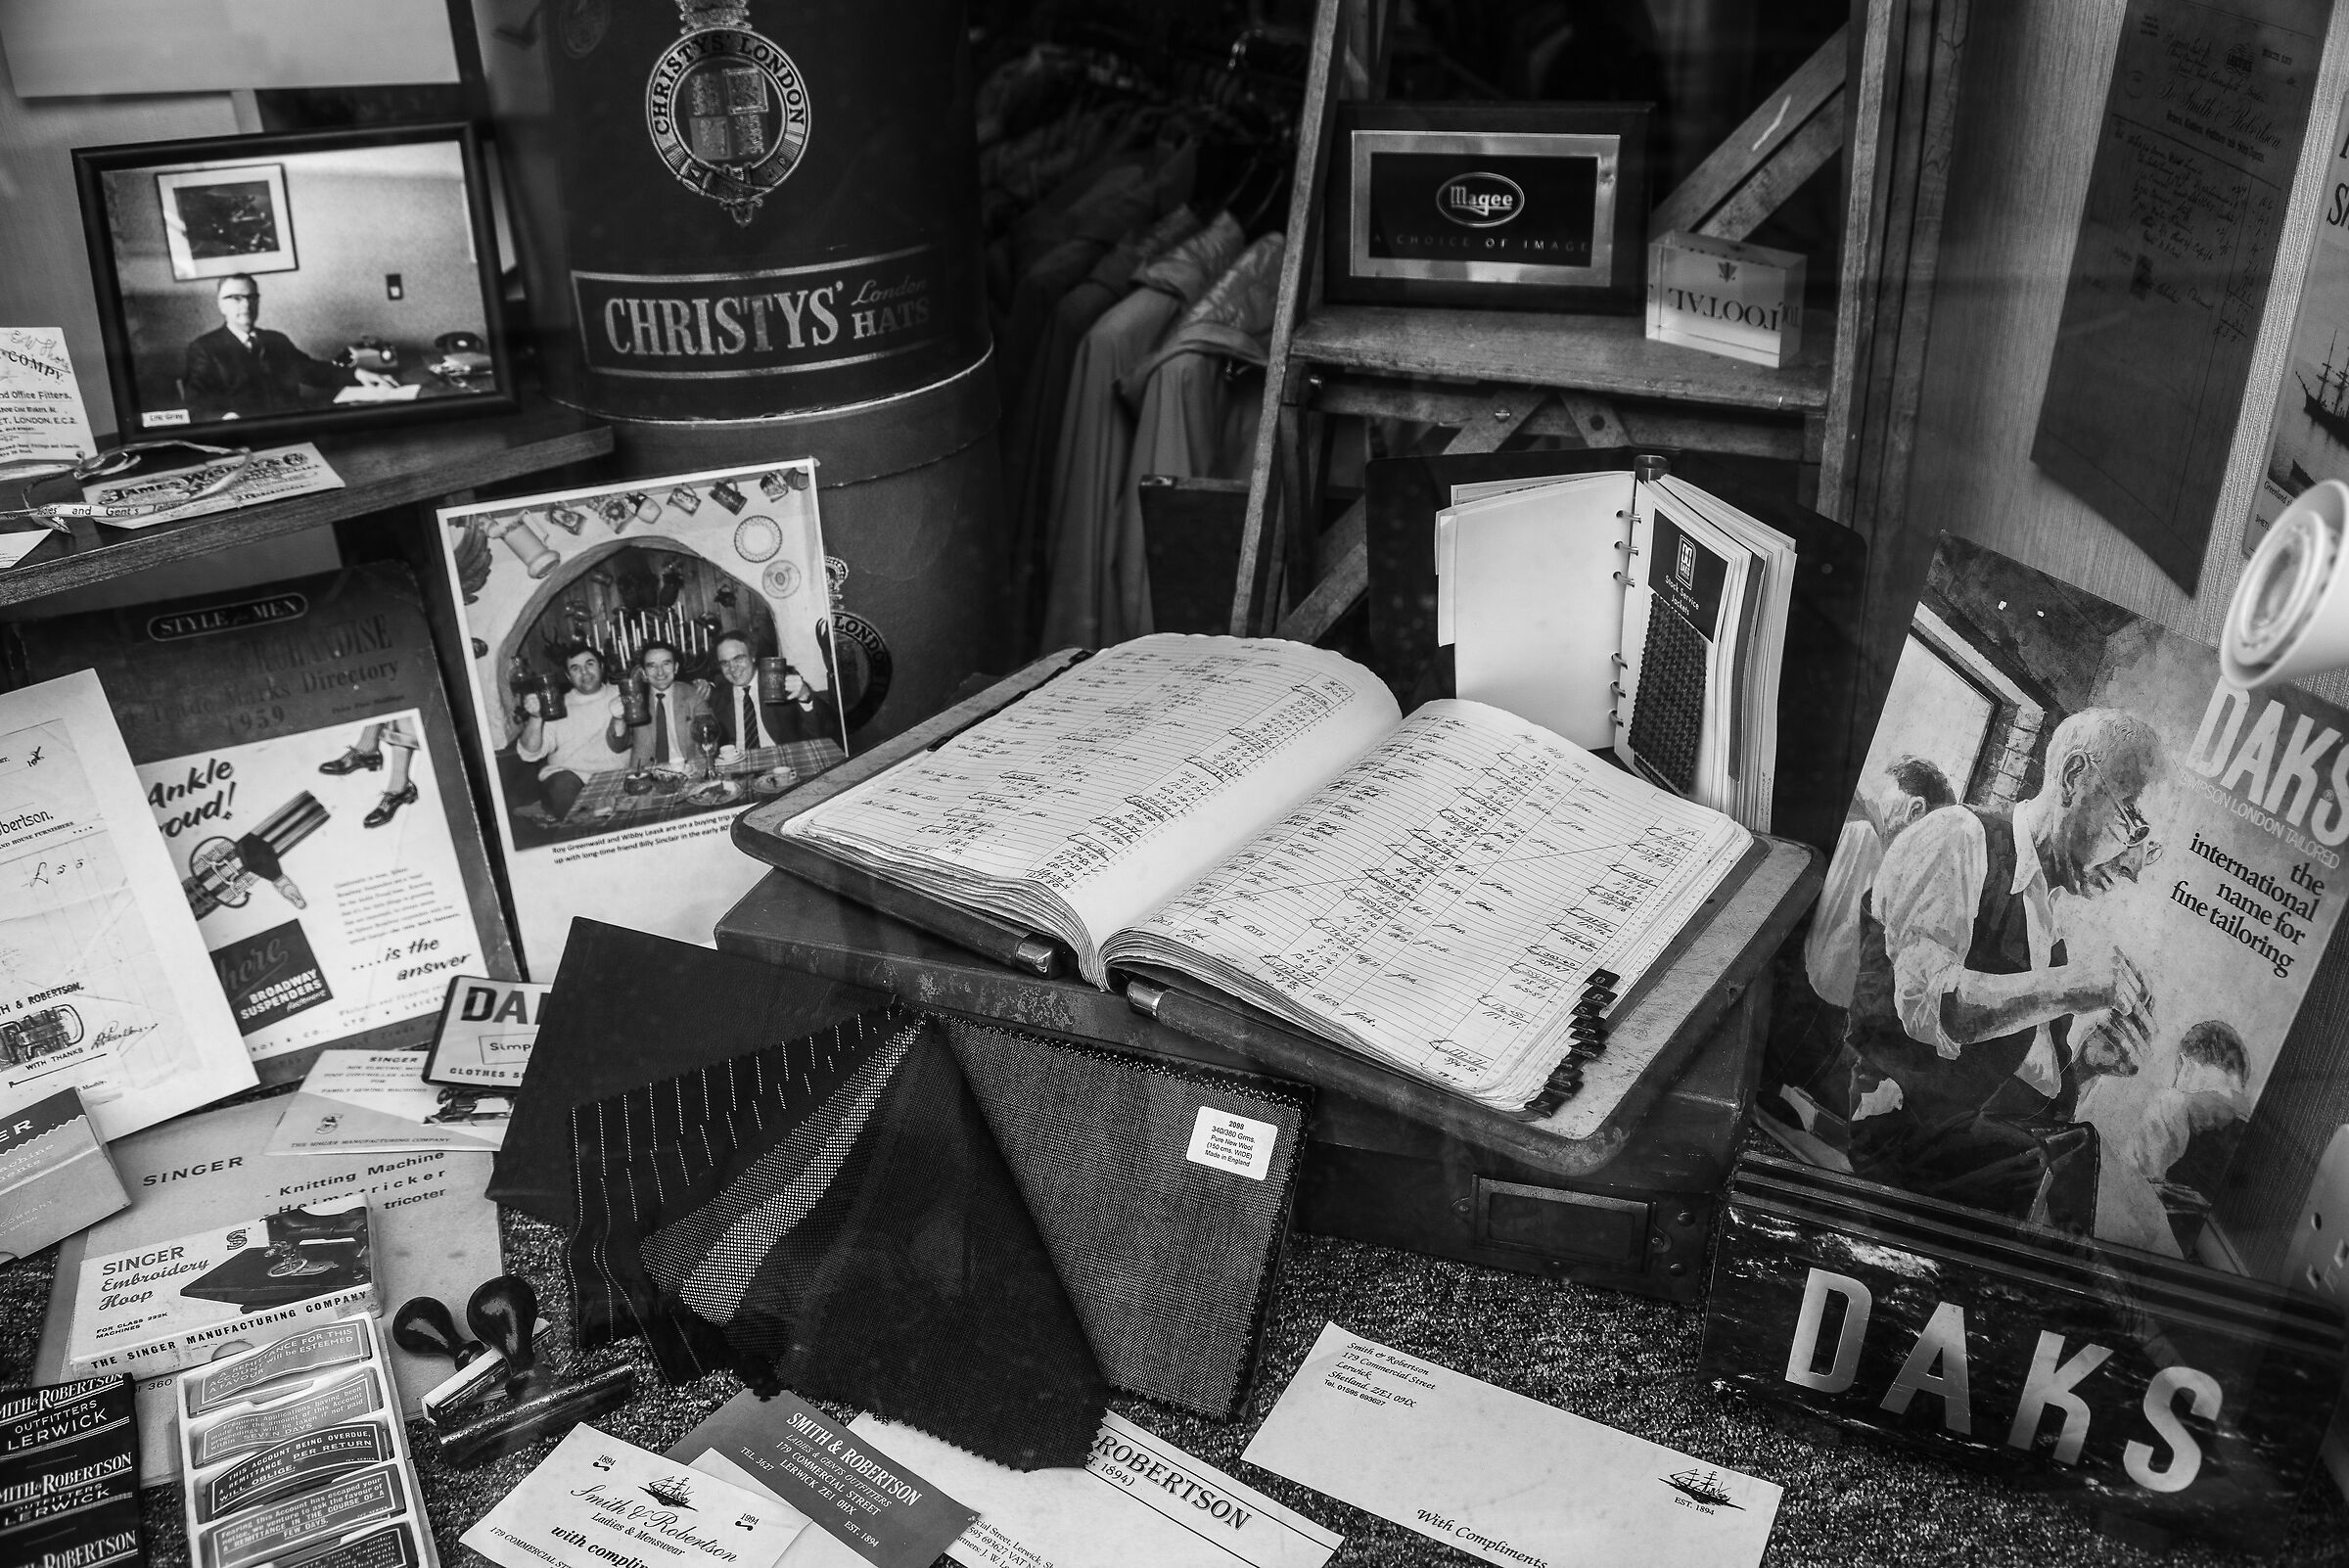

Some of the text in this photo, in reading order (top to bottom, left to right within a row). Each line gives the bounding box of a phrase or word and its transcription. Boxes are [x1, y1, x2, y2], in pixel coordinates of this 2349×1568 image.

[652, 33, 806, 135] CHRISTYS' LONDON
[1451, 185, 1513, 215] Magee
[1396, 235, 1589, 252] CHOICE OF IMAGE
[604, 279, 930, 355] CHRISTYS' London HATS
[1668, 287, 1782, 331] TOOTAL
[12, 391, 36, 399] Office
[72, 505, 92, 516] and
[1665, 574, 1700, 610] Stock Service
[1671, 594, 1690, 616] Jackets
[160, 598, 299, 636] STYLE MEN
[300, 659, 399, 695] Directory
[2185, 674, 2349, 848] DAKS
[148, 758, 234, 808] Ankle
[0, 810, 54, 836] bertson.
[161, 781, 237, 838] oud!
[2179, 773, 2234, 809] SIMPSON
[2230, 800, 2286, 840] LONDON
[12, 834, 34, 846] HOUSE
[552, 846, 566, 855] Roy
[607, 835, 620, 844] and
[694, 816, 716, 828] buying
[717, 813, 730, 824] trip
[553, 856, 564, 865] up
[565, 853, 580, 862] with
[617, 842, 637, 852] friend
[639, 839, 654, 850] Billy
[655, 834, 680, 845] Sinclair
[701, 826, 718, 837] early
[2188, 831, 2321, 922] international
[2290, 861, 2326, 897] the
[2170, 879, 2295, 980] fine tailoring
[2215, 881, 2307, 946] name for
[408, 937, 441, 956] the
[396, 952, 471, 982] answer
[240, 979, 323, 1020] SUSPENDERS
[249, 968, 317, 1005] BROADWAY
[25, 1046, 84, 1072] WITH THANKS
[449, 1066, 506, 1079] CLOTHES
[1204, 1149, 1221, 1159] Made
[1226, 1155, 1251, 1168] England
[1211, 1133, 1254, 1152] Pure New Wool
[142, 1156, 244, 1187] SINGER
[279, 1151, 445, 1196] Knitting Machine
[383, 1187, 446, 1210] tricoter
[100, 1257, 210, 1294] Embroidery
[102, 1245, 185, 1276] SINGER
[98, 1289, 154, 1312] Hoop
[90, 1290, 369, 1370] THE SINGER MANUFACTURING COMPANY
[95, 1323, 143, 1340] MACHINES
[96, 1316, 144, 1333] FOR CLASS
[300, 1327, 353, 1345] FOR THIS
[207, 1335, 354, 1388] ACCOUNT will ESTEEMED
[1333, 1360, 1372, 1381] Lerwick
[1342, 1351, 1436, 1391] 179 Commercial Street
[1347, 1342, 1431, 1377] Smith Robertson
[148, 1378, 173, 1392] 360
[344, 1385, 362, 1397] been
[1337, 1383, 1388, 1407] 01595 693627
[1370, 1385, 1393, 1400] ZE1
[1782, 1266, 2226, 1495] DAKS
[8, 1407, 108, 1451] LERWICK
[15, 1399, 98, 1434] OUTFITTERS
[42, 1451, 133, 1496] ROBERTSON
[227, 1430, 372, 1482] THIS ACCOUNT BEING OVERDUE,
[227, 1440, 373, 1489] REMITTANCE PER RETURN
[598, 1453, 618, 1467] 1894
[740, 1445, 776, 1473] TEL. 3627
[784, 1432, 894, 1508] LADIES GENTS OUTFITTERS
[785, 1411, 924, 1507] SMITH ROBERTSON
[775, 1440, 883, 1517] 179 COMMERCIAL STREET
[779, 1457, 837, 1501] LERWICK ZE1
[1095, 1434, 1254, 1533] ROBERTSON
[1100, 1461, 1136, 1488] 1894)
[218, 1487, 246, 1502] WILL
[275, 1476, 383, 1516] Account your
[290, 1517, 301, 1526] IN
[306, 1509, 323, 1521] THE
[327, 1497, 361, 1514] COURSE
[1674, 1497, 1716, 1517] EST. 1894
[283, 1517, 329, 1538] FEW DAYS.
[570, 1483, 739, 1564] Smith Robertson
[590, 1511, 687, 1557] Ladies Menswear
[739, 1512, 760, 1526] 1994
[843, 1519, 881, 1548] EST. 1894
[489, 1526, 558, 1565] 179 COMMERCIAL
[550, 1525, 586, 1551] with
[981, 1535, 1028, 1567] 693627 VAT
[989, 1526, 1042, 1566] Street, Lerwick,
[1415, 1507, 1550, 1568] With Compliments
